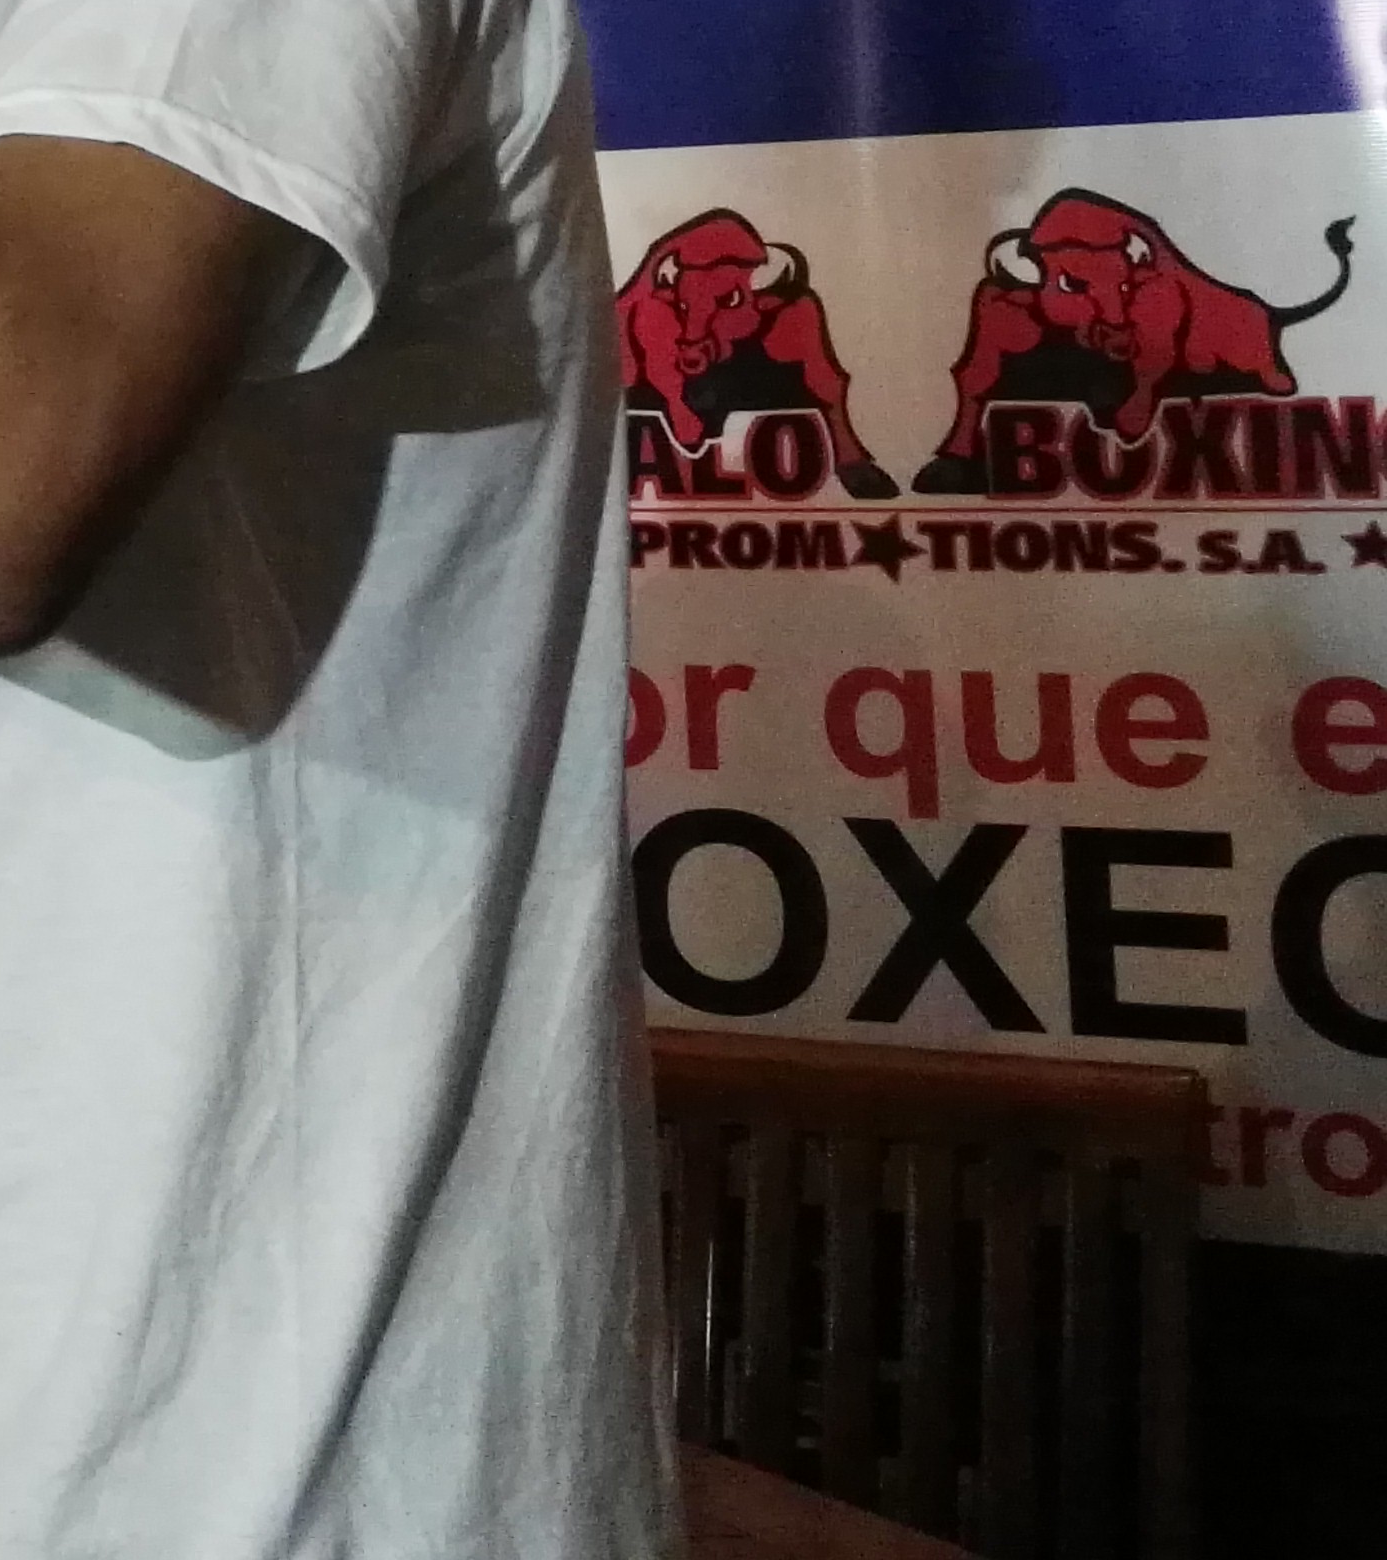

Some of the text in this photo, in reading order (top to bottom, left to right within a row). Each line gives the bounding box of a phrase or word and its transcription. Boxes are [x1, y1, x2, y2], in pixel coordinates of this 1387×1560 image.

[985, 395, 1387, 502] BOXIN
[1197, 529, 1326, 575] S.A.
[825, 665, 1211, 820] que
